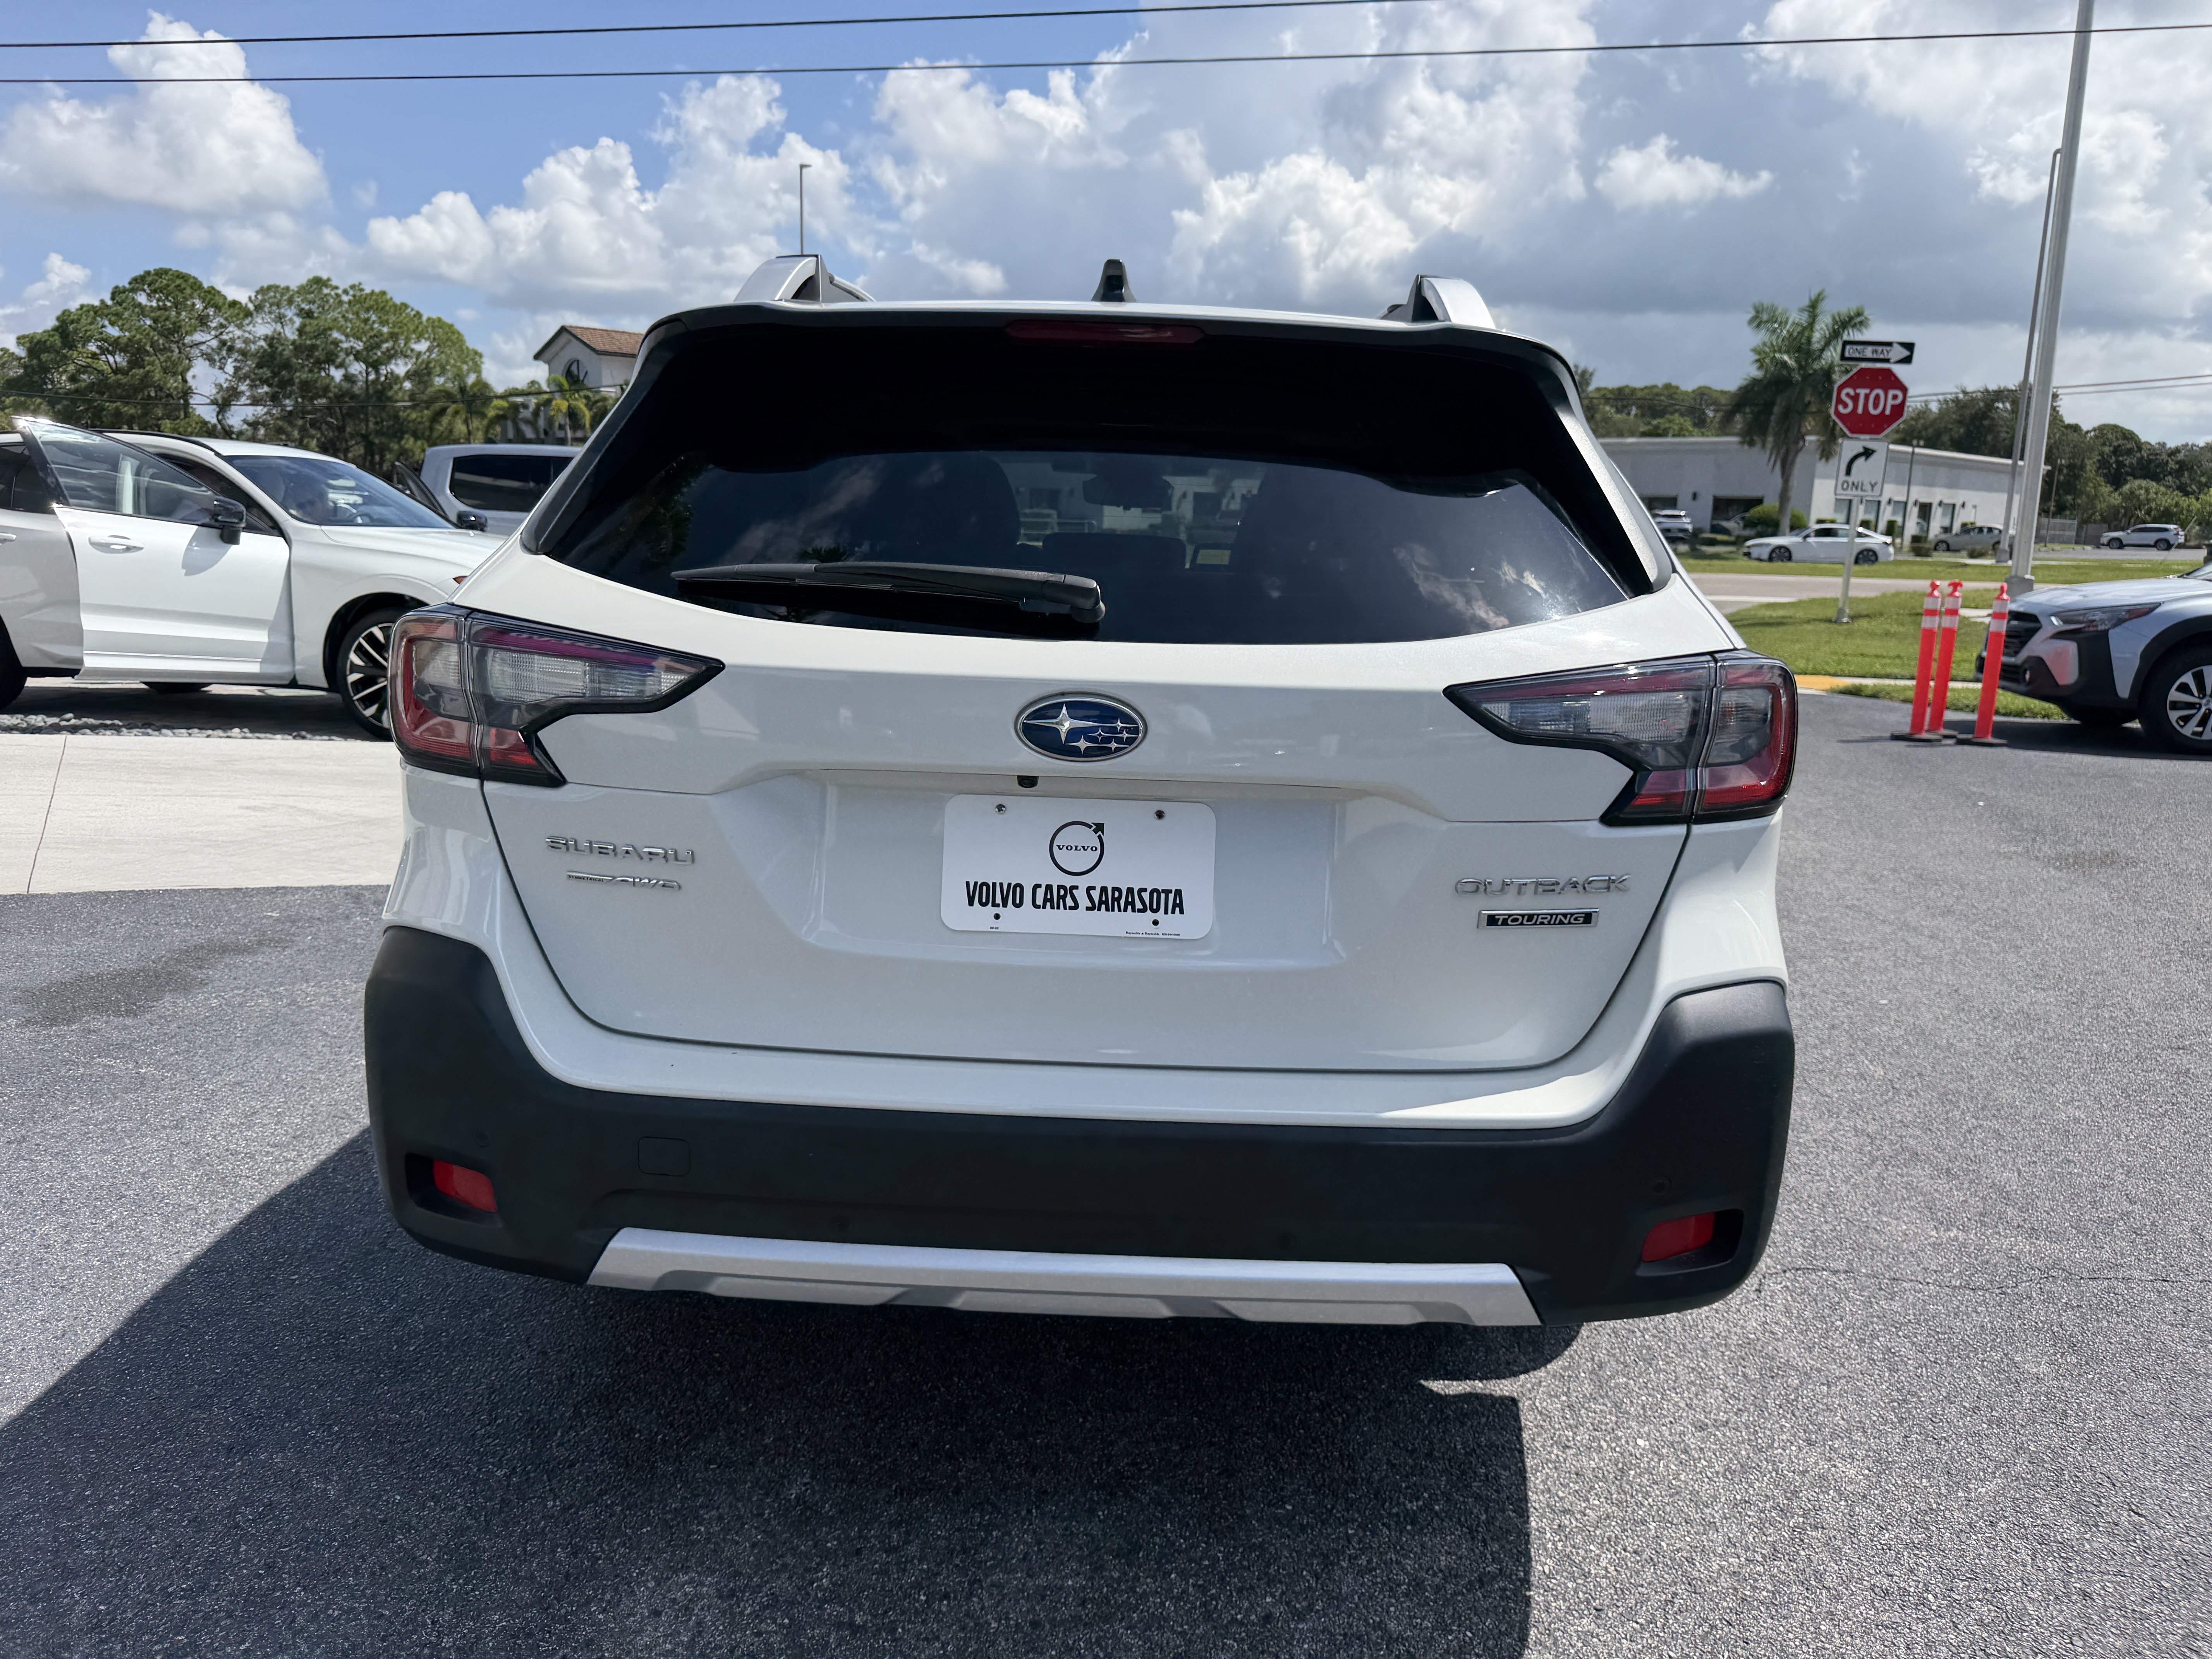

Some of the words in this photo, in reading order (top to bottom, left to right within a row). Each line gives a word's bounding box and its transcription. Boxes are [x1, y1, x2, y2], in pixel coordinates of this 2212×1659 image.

[1847, 347, 1867, 357] ONE
[1871, 348, 1892, 357] WAY
[1837, 388, 1903, 416] STOP
[1841, 480, 1878, 493] ONLY
[545, 836, 695, 864] SUBARU
[1455, 874, 1631, 896] OUTBACK
[965, 881, 1024, 908] VOLVO
[1031, 884, 1079, 910] CARS
[1086, 886, 1185, 915] SARASOTA
[1495, 914, 1585, 925] TOURING
